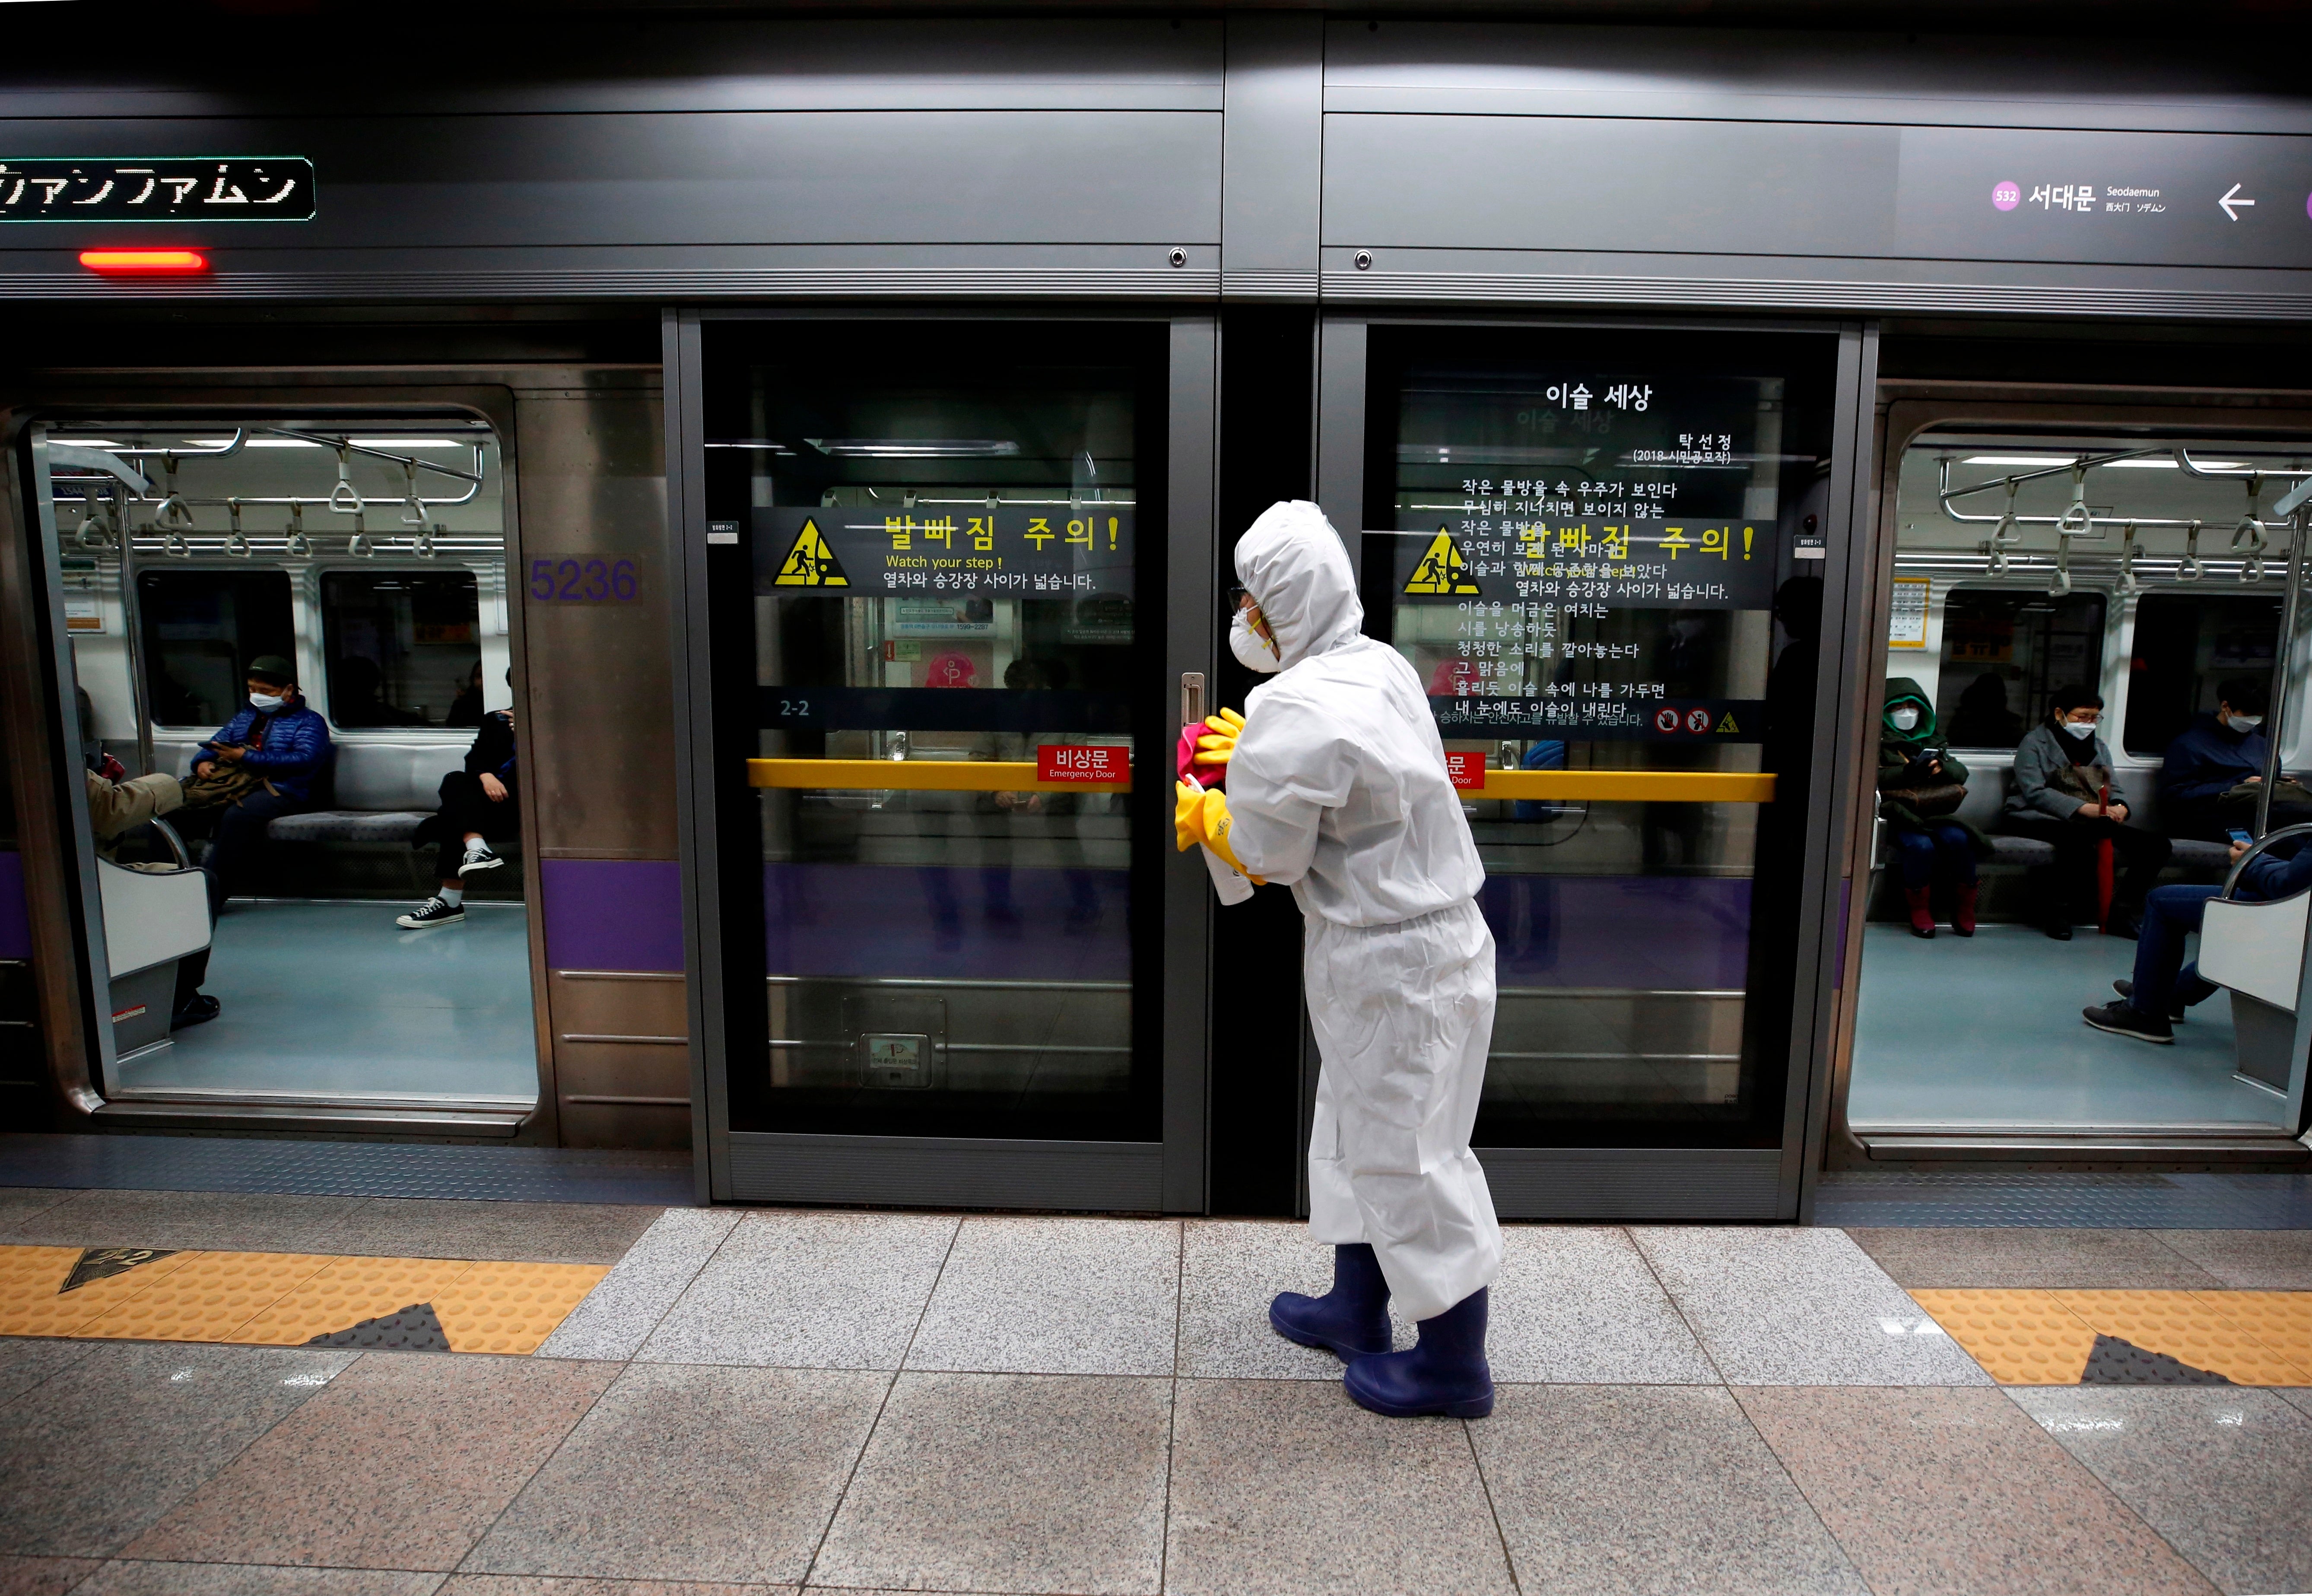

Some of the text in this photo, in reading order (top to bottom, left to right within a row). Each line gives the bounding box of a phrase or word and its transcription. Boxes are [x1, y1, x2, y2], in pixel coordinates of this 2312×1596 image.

[1996, 184, 2096, 212] 532 서대문
[2106, 186, 2160, 197] Seodaemun
[1547, 383, 1652, 411] 이슬 세상
[1633, 449, 1731, 465] (2018 시민공모작)
[1462, 479, 1677, 498] 작은 물방울 속 우주가 보인다
[1462, 500, 1664, 519] 무심히 지나치면 보이지 않는
[886, 515, 993, 550] 발빠짐
[1461, 520, 1492, 536] 작은
[1460, 540, 1505, 556] 우연히
[1551, 542, 1565, 558] 된
[886, 555, 927, 568] Watch
[932, 558, 962, 570] your
[1460, 561, 1506, 576] 이슬과
[1621, 564, 1667, 579] 보았다
[531, 559, 637, 601] 5236
[883, 572, 1096, 590] 열차와 승강장 사이가 넓습니다.
[1516, 580, 1728, 600] 열차와 승강장 사이가 넓습니다.
[1458, 600, 1609, 619] 이슬을 머금은 여치는
[1458, 621, 1557, 638] 시를 낭송하듯
[1458, 641, 1639, 659] 청청한 소리를 깔아놓는다
[1456, 661, 1524, 677] 그 맑음에
[1508, 681, 1538, 697] 이슬
[1545, 682, 1576, 698] 속에
[1583, 682, 1613, 698] 나를
[1620, 683, 1664, 699] 가두면
[781, 700, 809, 715] 2-2
[1455, 700, 1469, 716] 내
[1477, 700, 1523, 717] 눈에도
[1530, 701, 1574, 718] 이슬이
[1582, 701, 1627, 718] 내린다
[1582, 713, 1594, 726] 수
[1057, 749, 1109, 768] 비상문
[1049, 769, 1115, 779] Emergency Door
[1452, 776, 1472, 784] Door
